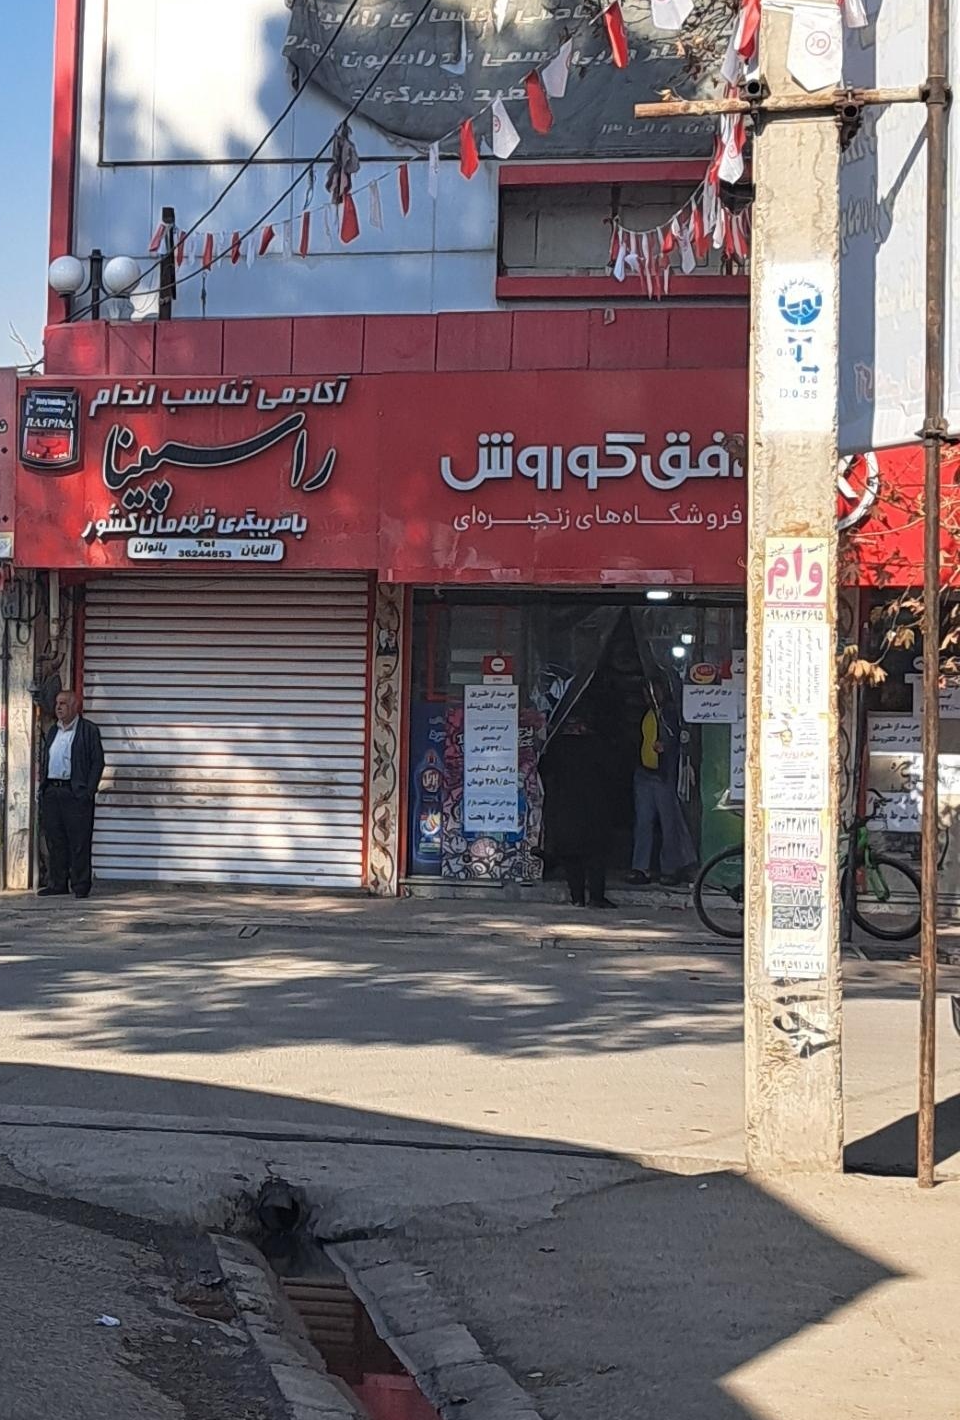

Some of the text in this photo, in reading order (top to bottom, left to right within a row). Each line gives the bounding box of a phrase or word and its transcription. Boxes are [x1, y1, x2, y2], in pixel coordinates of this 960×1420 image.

[88, 375, 353, 417] آکادمی تناسب اندام
[25, 417, 75, 429] RASPINA
[102, 411, 337, 513] راسپینا
[440, 431, 646, 492] کوروش
[81, 504, 140, 539] کشور
[139, 508, 217, 538] قهرمان
[133, 541, 168, 556] بانوان
[195, 539, 216, 548] Tel
[767, 543, 824, 597] وام
